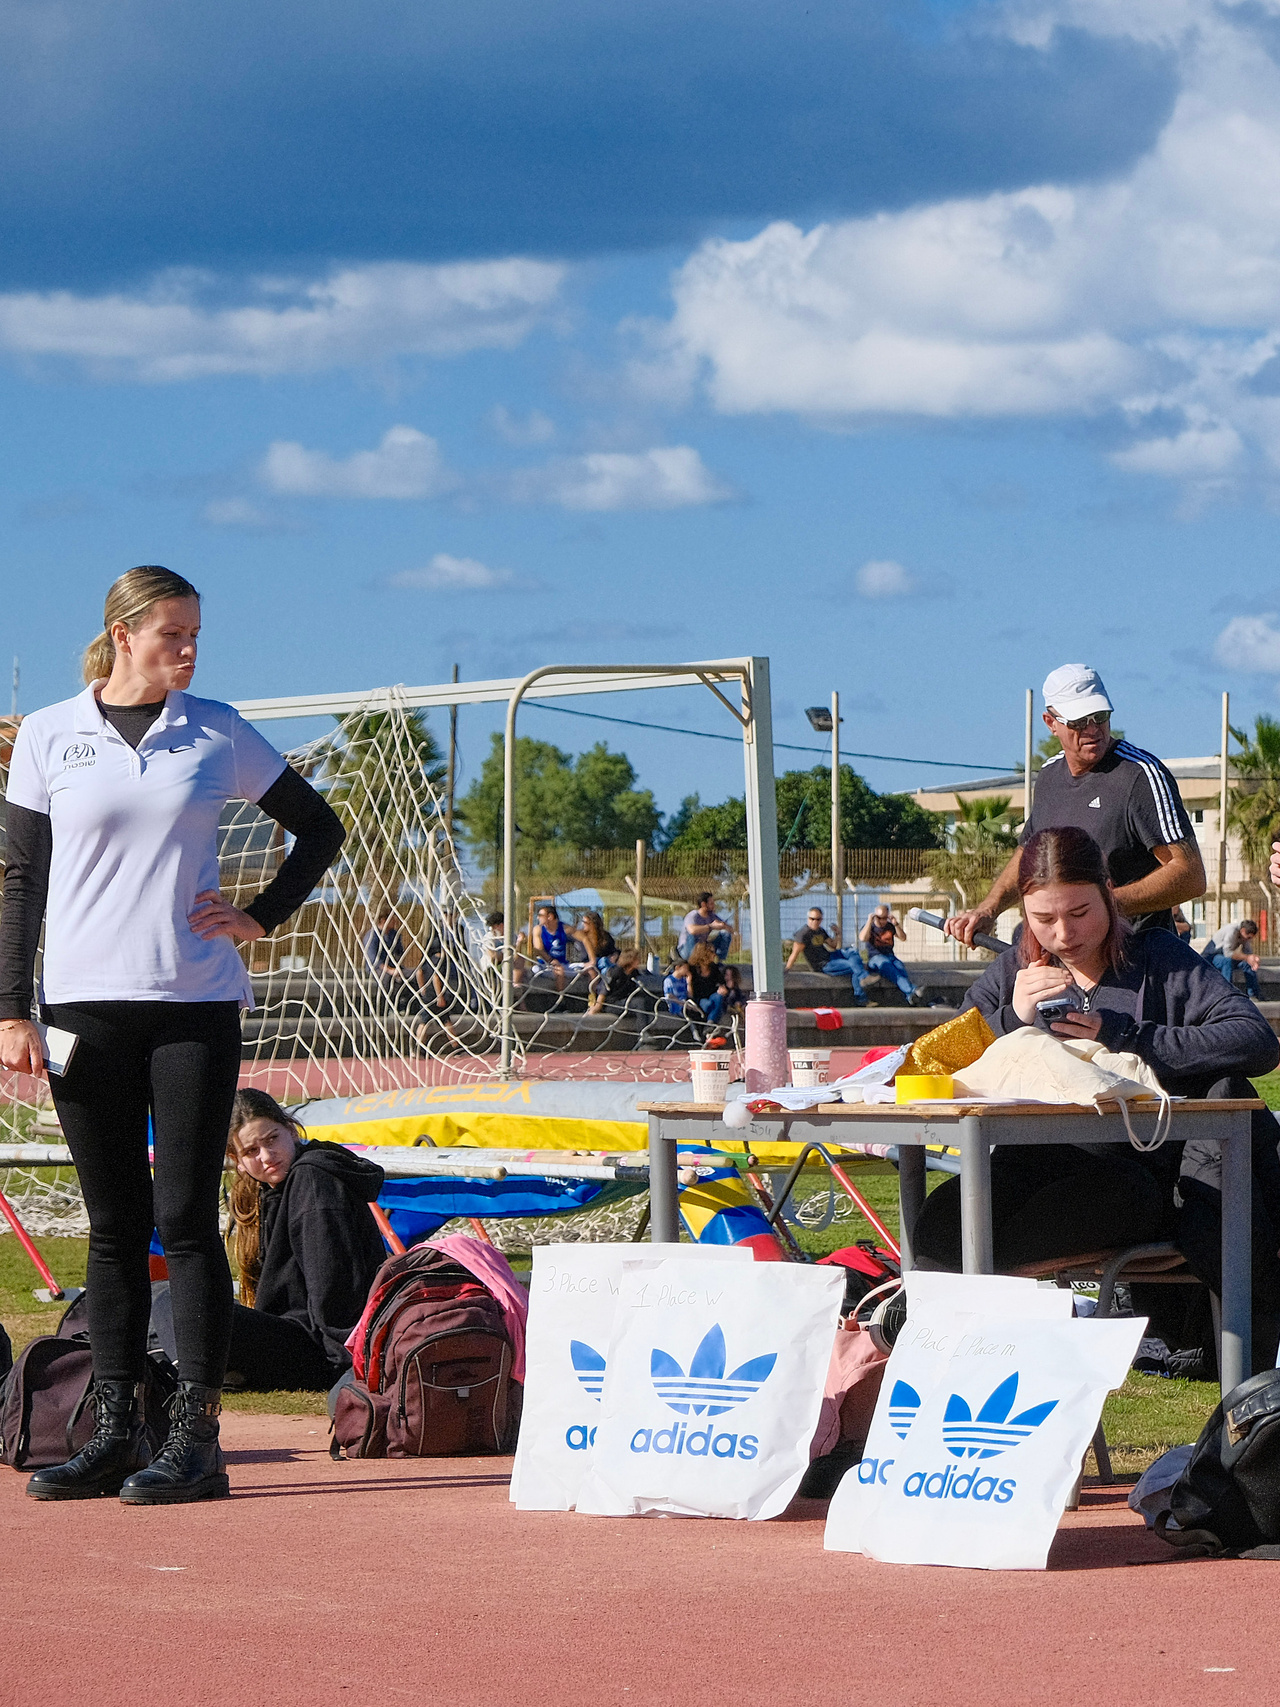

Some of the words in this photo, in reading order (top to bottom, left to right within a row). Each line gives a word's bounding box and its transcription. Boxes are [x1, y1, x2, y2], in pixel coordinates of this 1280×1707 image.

[911, 1327, 948, 1352] Plac
[629, 1421, 760, 1460] adidas
[903, 1464, 1017, 1504] adidas
